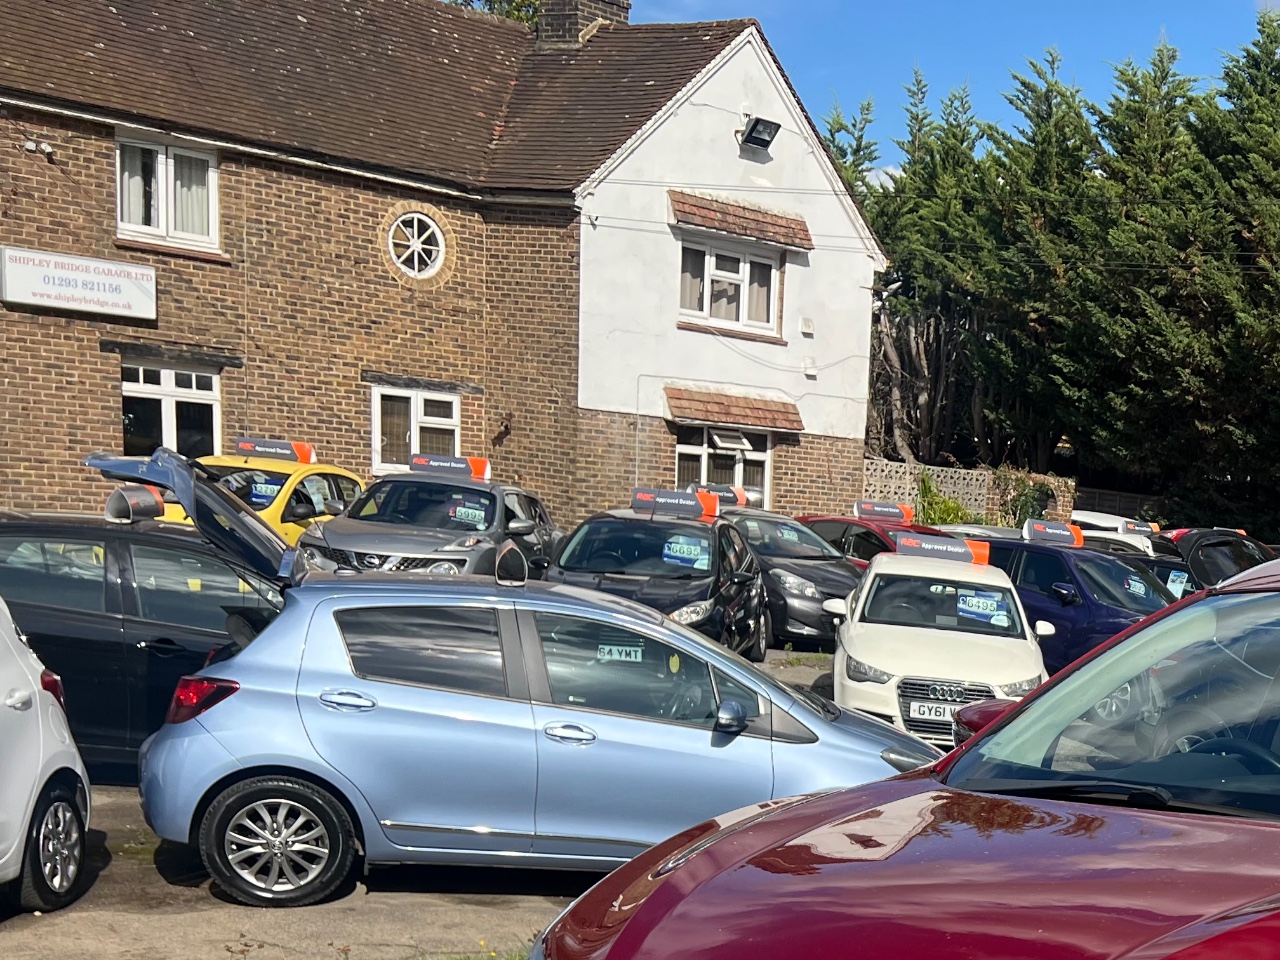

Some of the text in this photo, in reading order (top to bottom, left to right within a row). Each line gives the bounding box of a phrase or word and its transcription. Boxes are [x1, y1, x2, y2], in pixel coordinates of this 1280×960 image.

[8, 255, 153, 282] SHIPLEY BRIDGE GARAGE LTD
[43, 274, 122, 294] 01293 821156
[31, 290, 133, 310] www.shipleybridge.co.uk
[921, 542, 946, 551] Approved
[946, 543, 965, 553] Dealer
[616, 648, 640, 660] YMT
[918, 704, 946, 718] GY61
